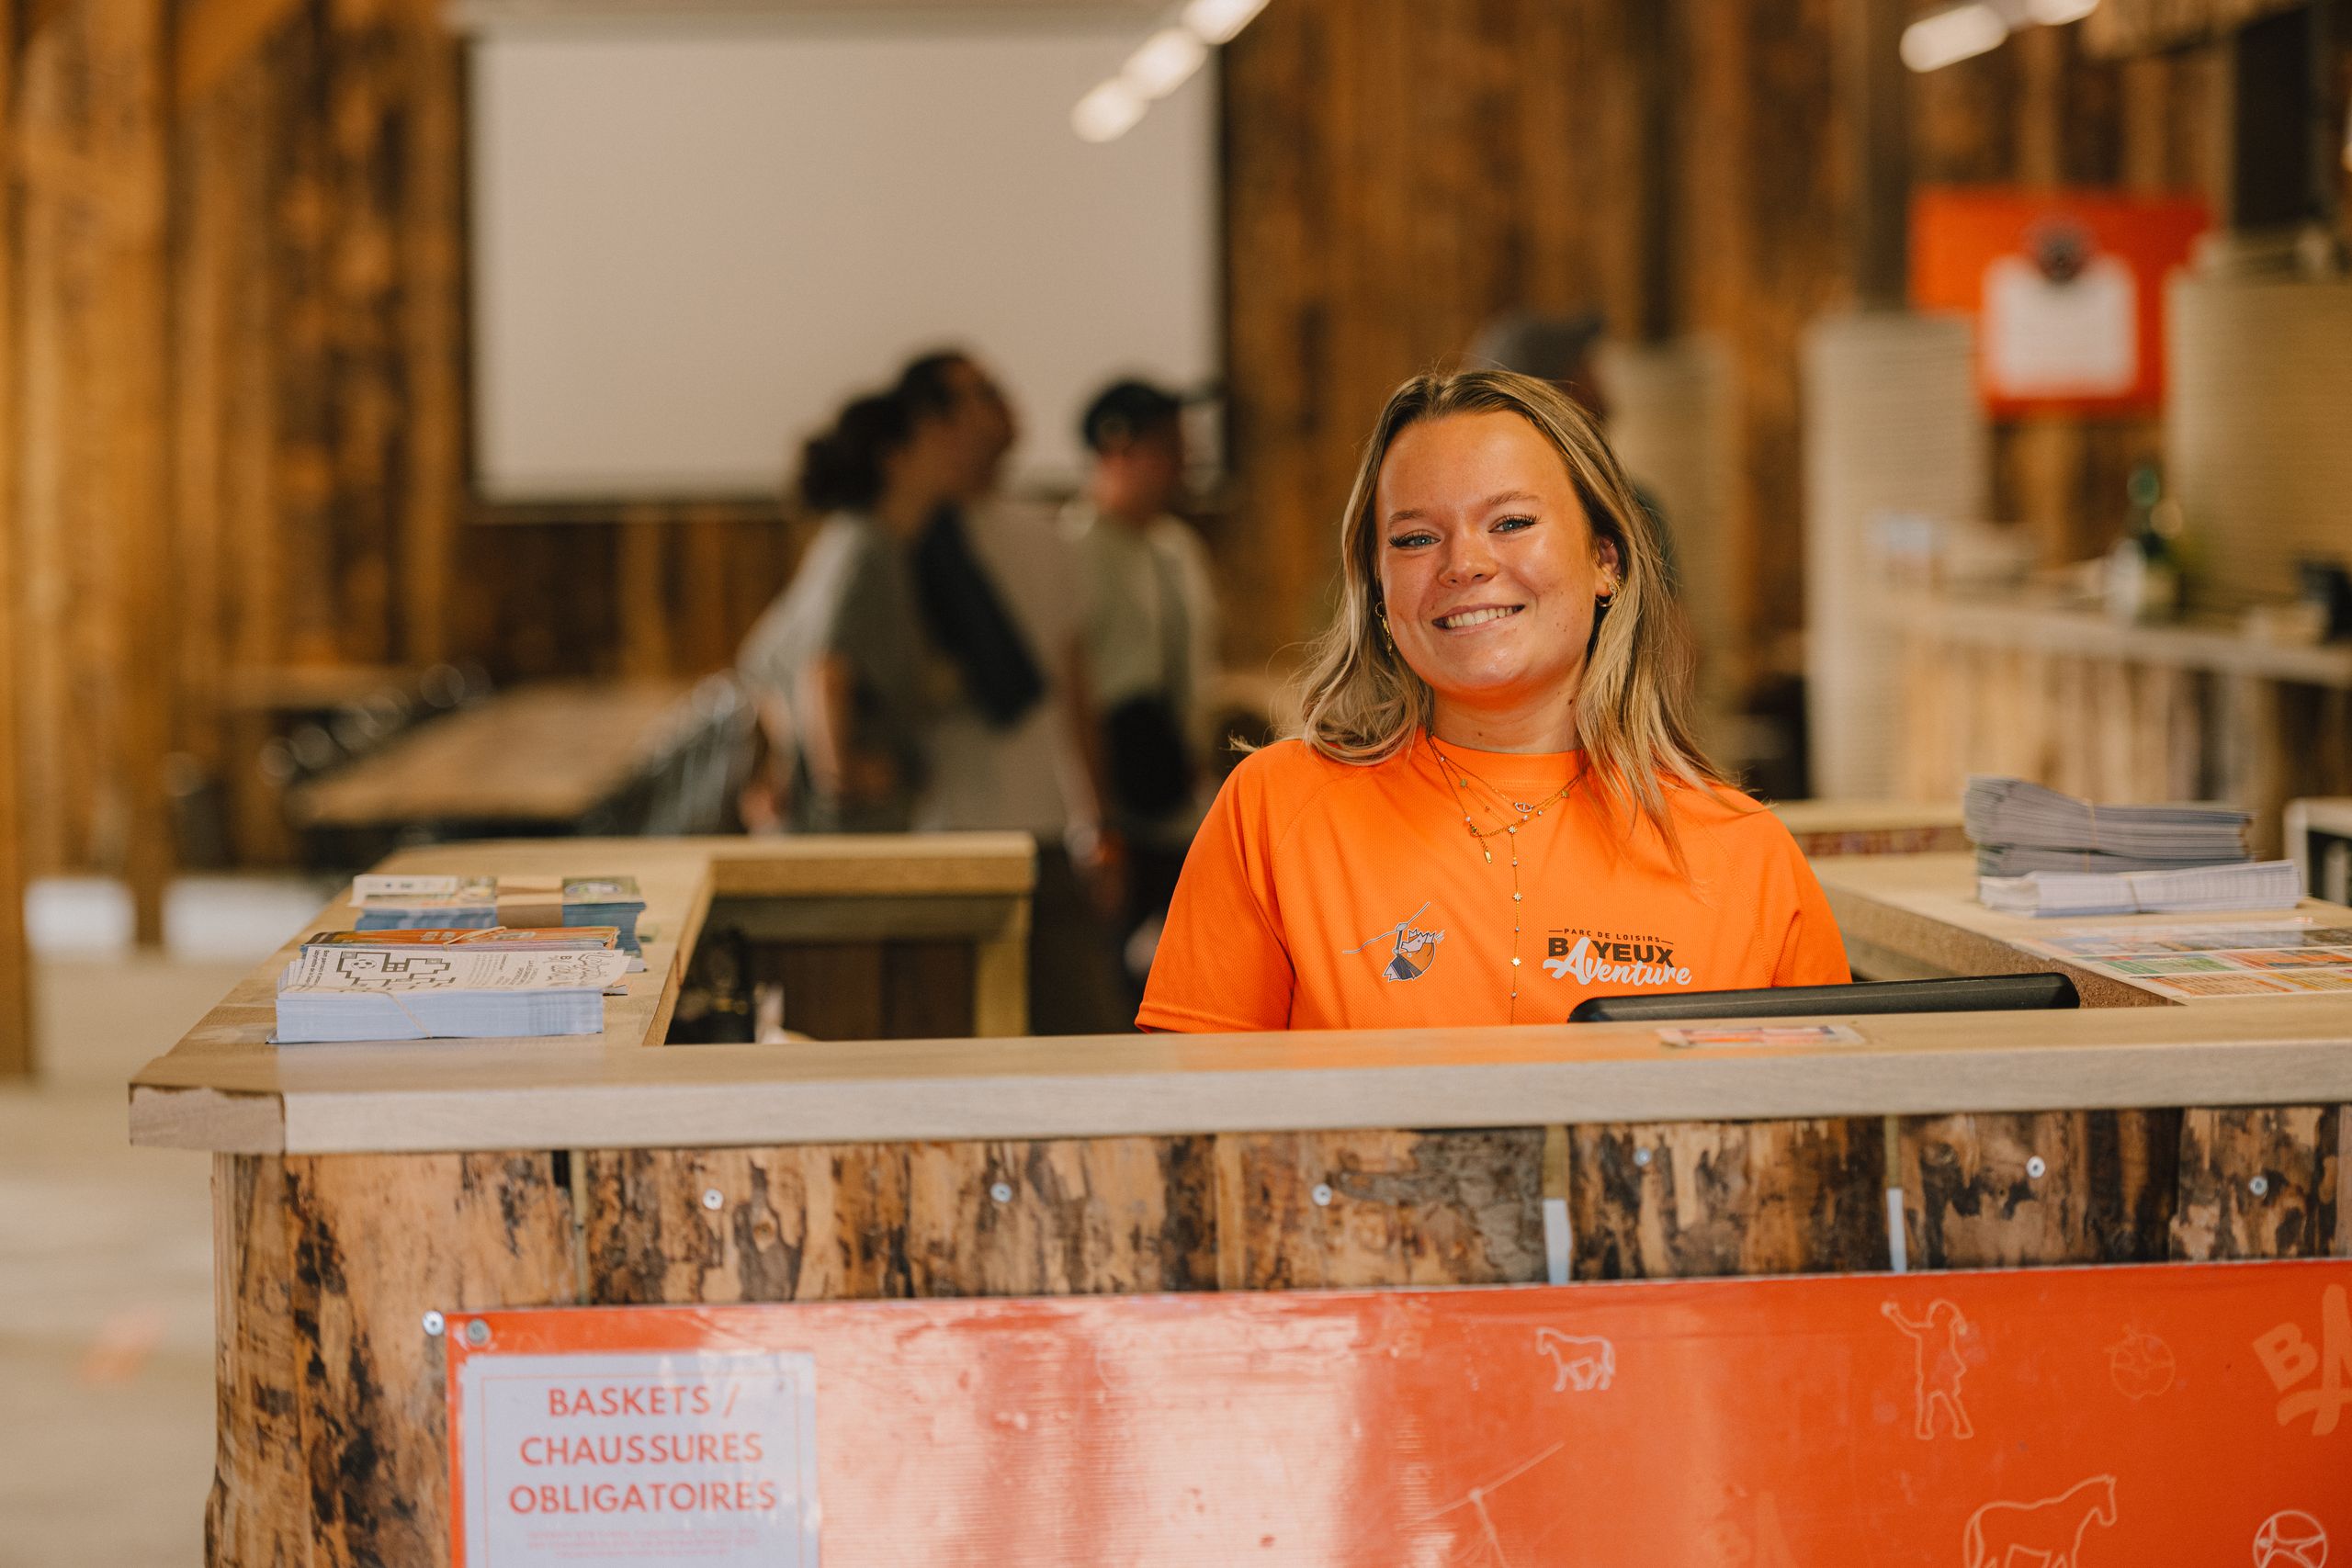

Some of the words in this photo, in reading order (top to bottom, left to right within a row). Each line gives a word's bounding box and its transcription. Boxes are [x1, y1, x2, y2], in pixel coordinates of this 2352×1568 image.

[1564, 928, 1591, 937] PARC
[1616, 933, 1660, 942] LOISIRS
[548, 1385, 711, 1417] BASKETS
[519, 1432, 764, 1467] CHAUSSURES
[508, 1480, 778, 1516] OBLIGATOIRES
